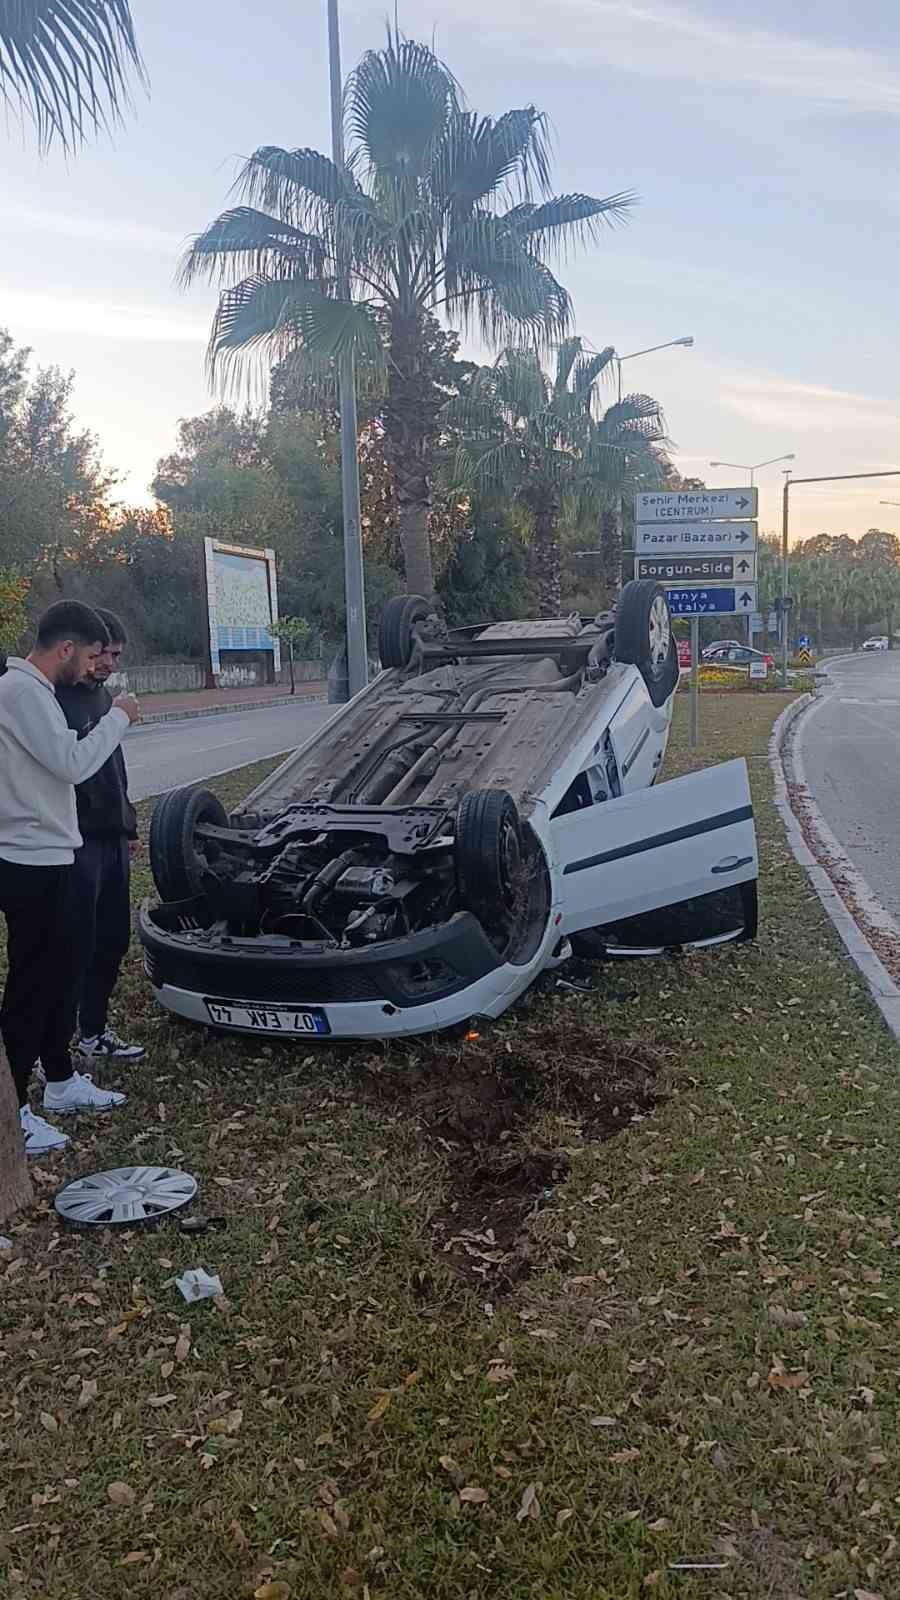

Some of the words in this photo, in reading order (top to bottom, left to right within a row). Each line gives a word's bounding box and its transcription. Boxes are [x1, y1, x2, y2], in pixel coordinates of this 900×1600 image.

[678, 494, 729, 505] Merkezi
[655, 506, 714, 517] (CENTRUM)
[668, 591, 708, 602] lanya
[670, 602, 716, 613] ntalya
[211, 1005, 232, 1022] 44
[247, 1010, 282, 1028] EAK
[294, 1012, 315, 1030] 07
